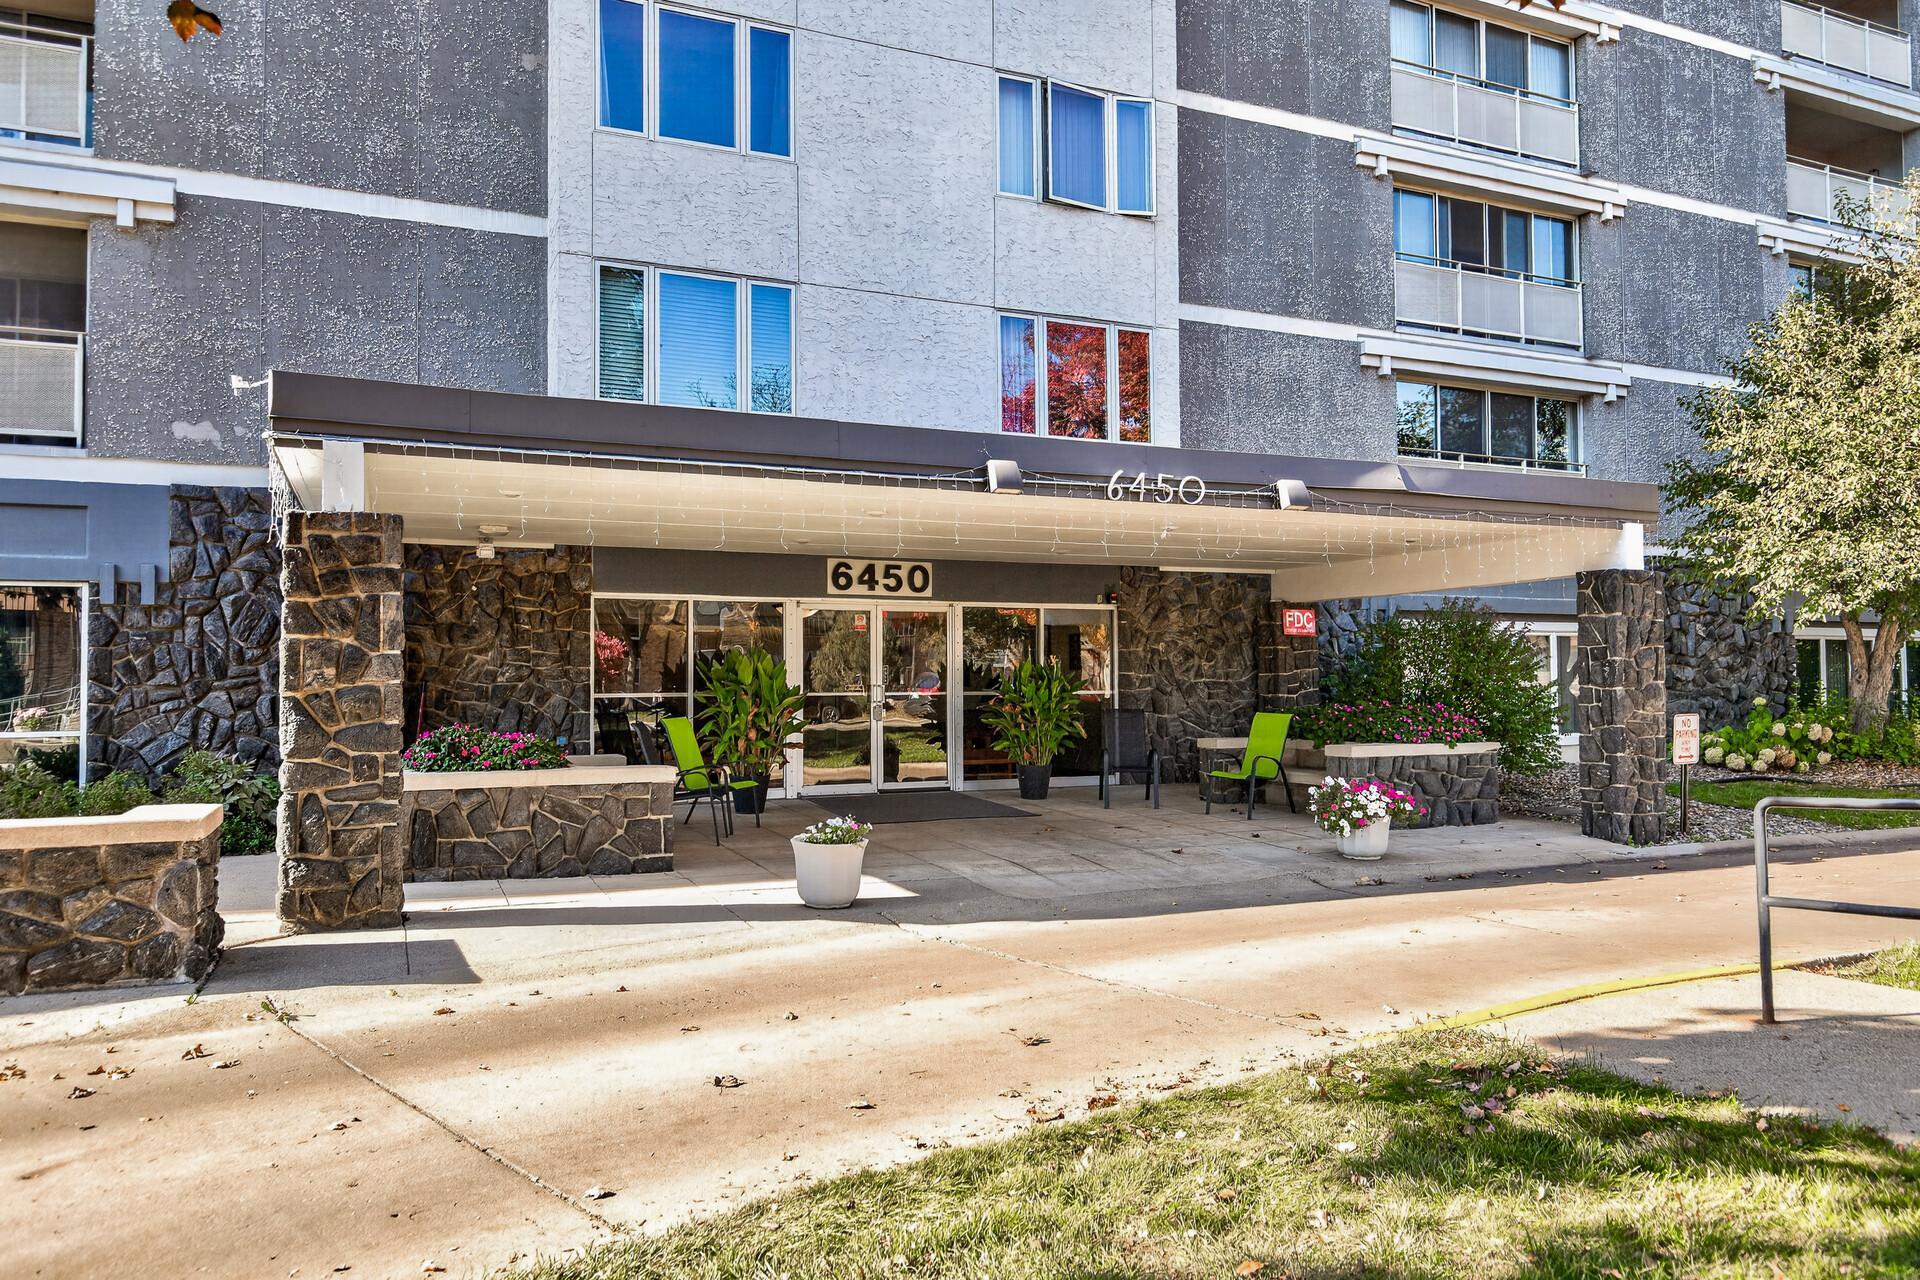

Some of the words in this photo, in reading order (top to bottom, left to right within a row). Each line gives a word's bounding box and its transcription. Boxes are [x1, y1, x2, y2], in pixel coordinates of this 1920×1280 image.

[1107, 469, 1206, 505] 6450
[831, 561, 930, 593] 6450
[1285, 611, 1313, 628] FDC
[1681, 718, 1692, 728] NO
[1675, 729, 1697, 738] PARKING
